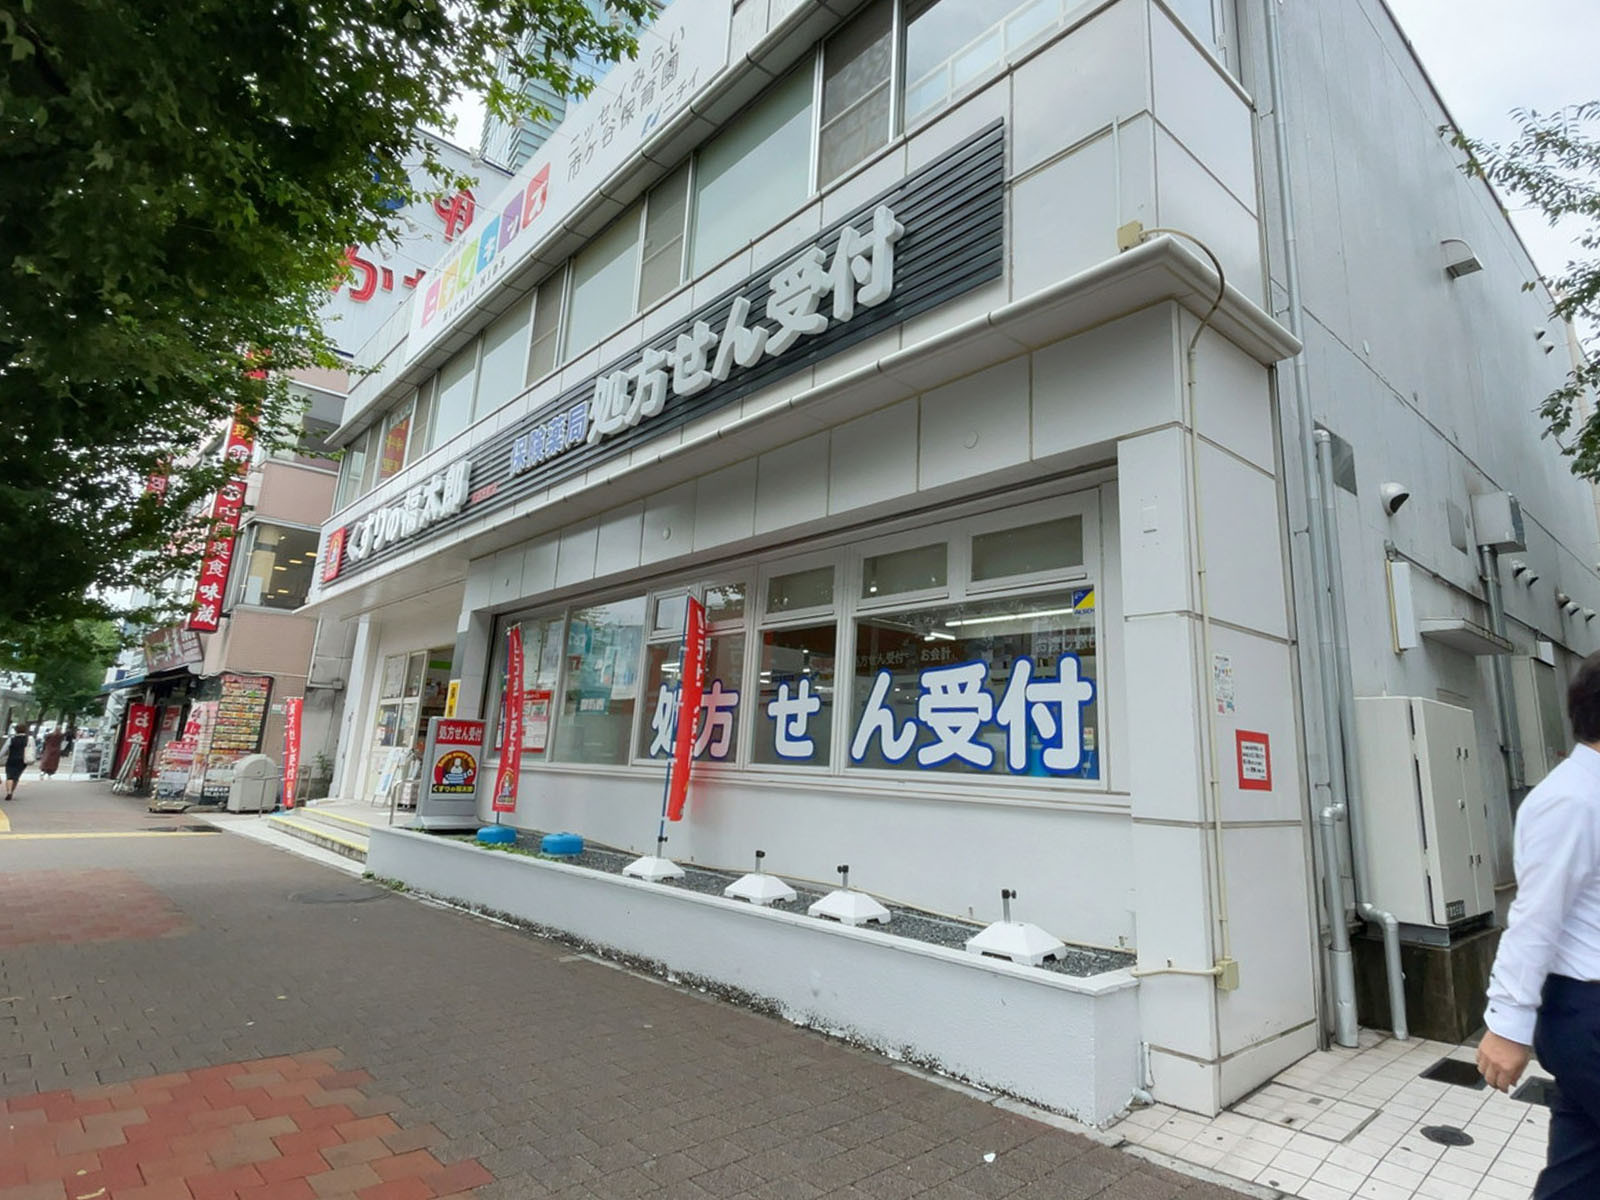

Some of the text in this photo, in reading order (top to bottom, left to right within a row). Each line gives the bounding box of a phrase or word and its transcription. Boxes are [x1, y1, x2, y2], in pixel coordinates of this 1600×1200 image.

[568, 26, 685, 159] ニッセイみらい
[662, 66, 700, 114] ニチイ
[587, 204, 904, 445] 処方せん受付
[508, 401, 592, 476] 保険薬局
[347, 459, 473, 563] くすりの福太郎
[438, 725, 482, 741] 処方せん受付
[650, 653, 1094, 776] 処方せん受付
